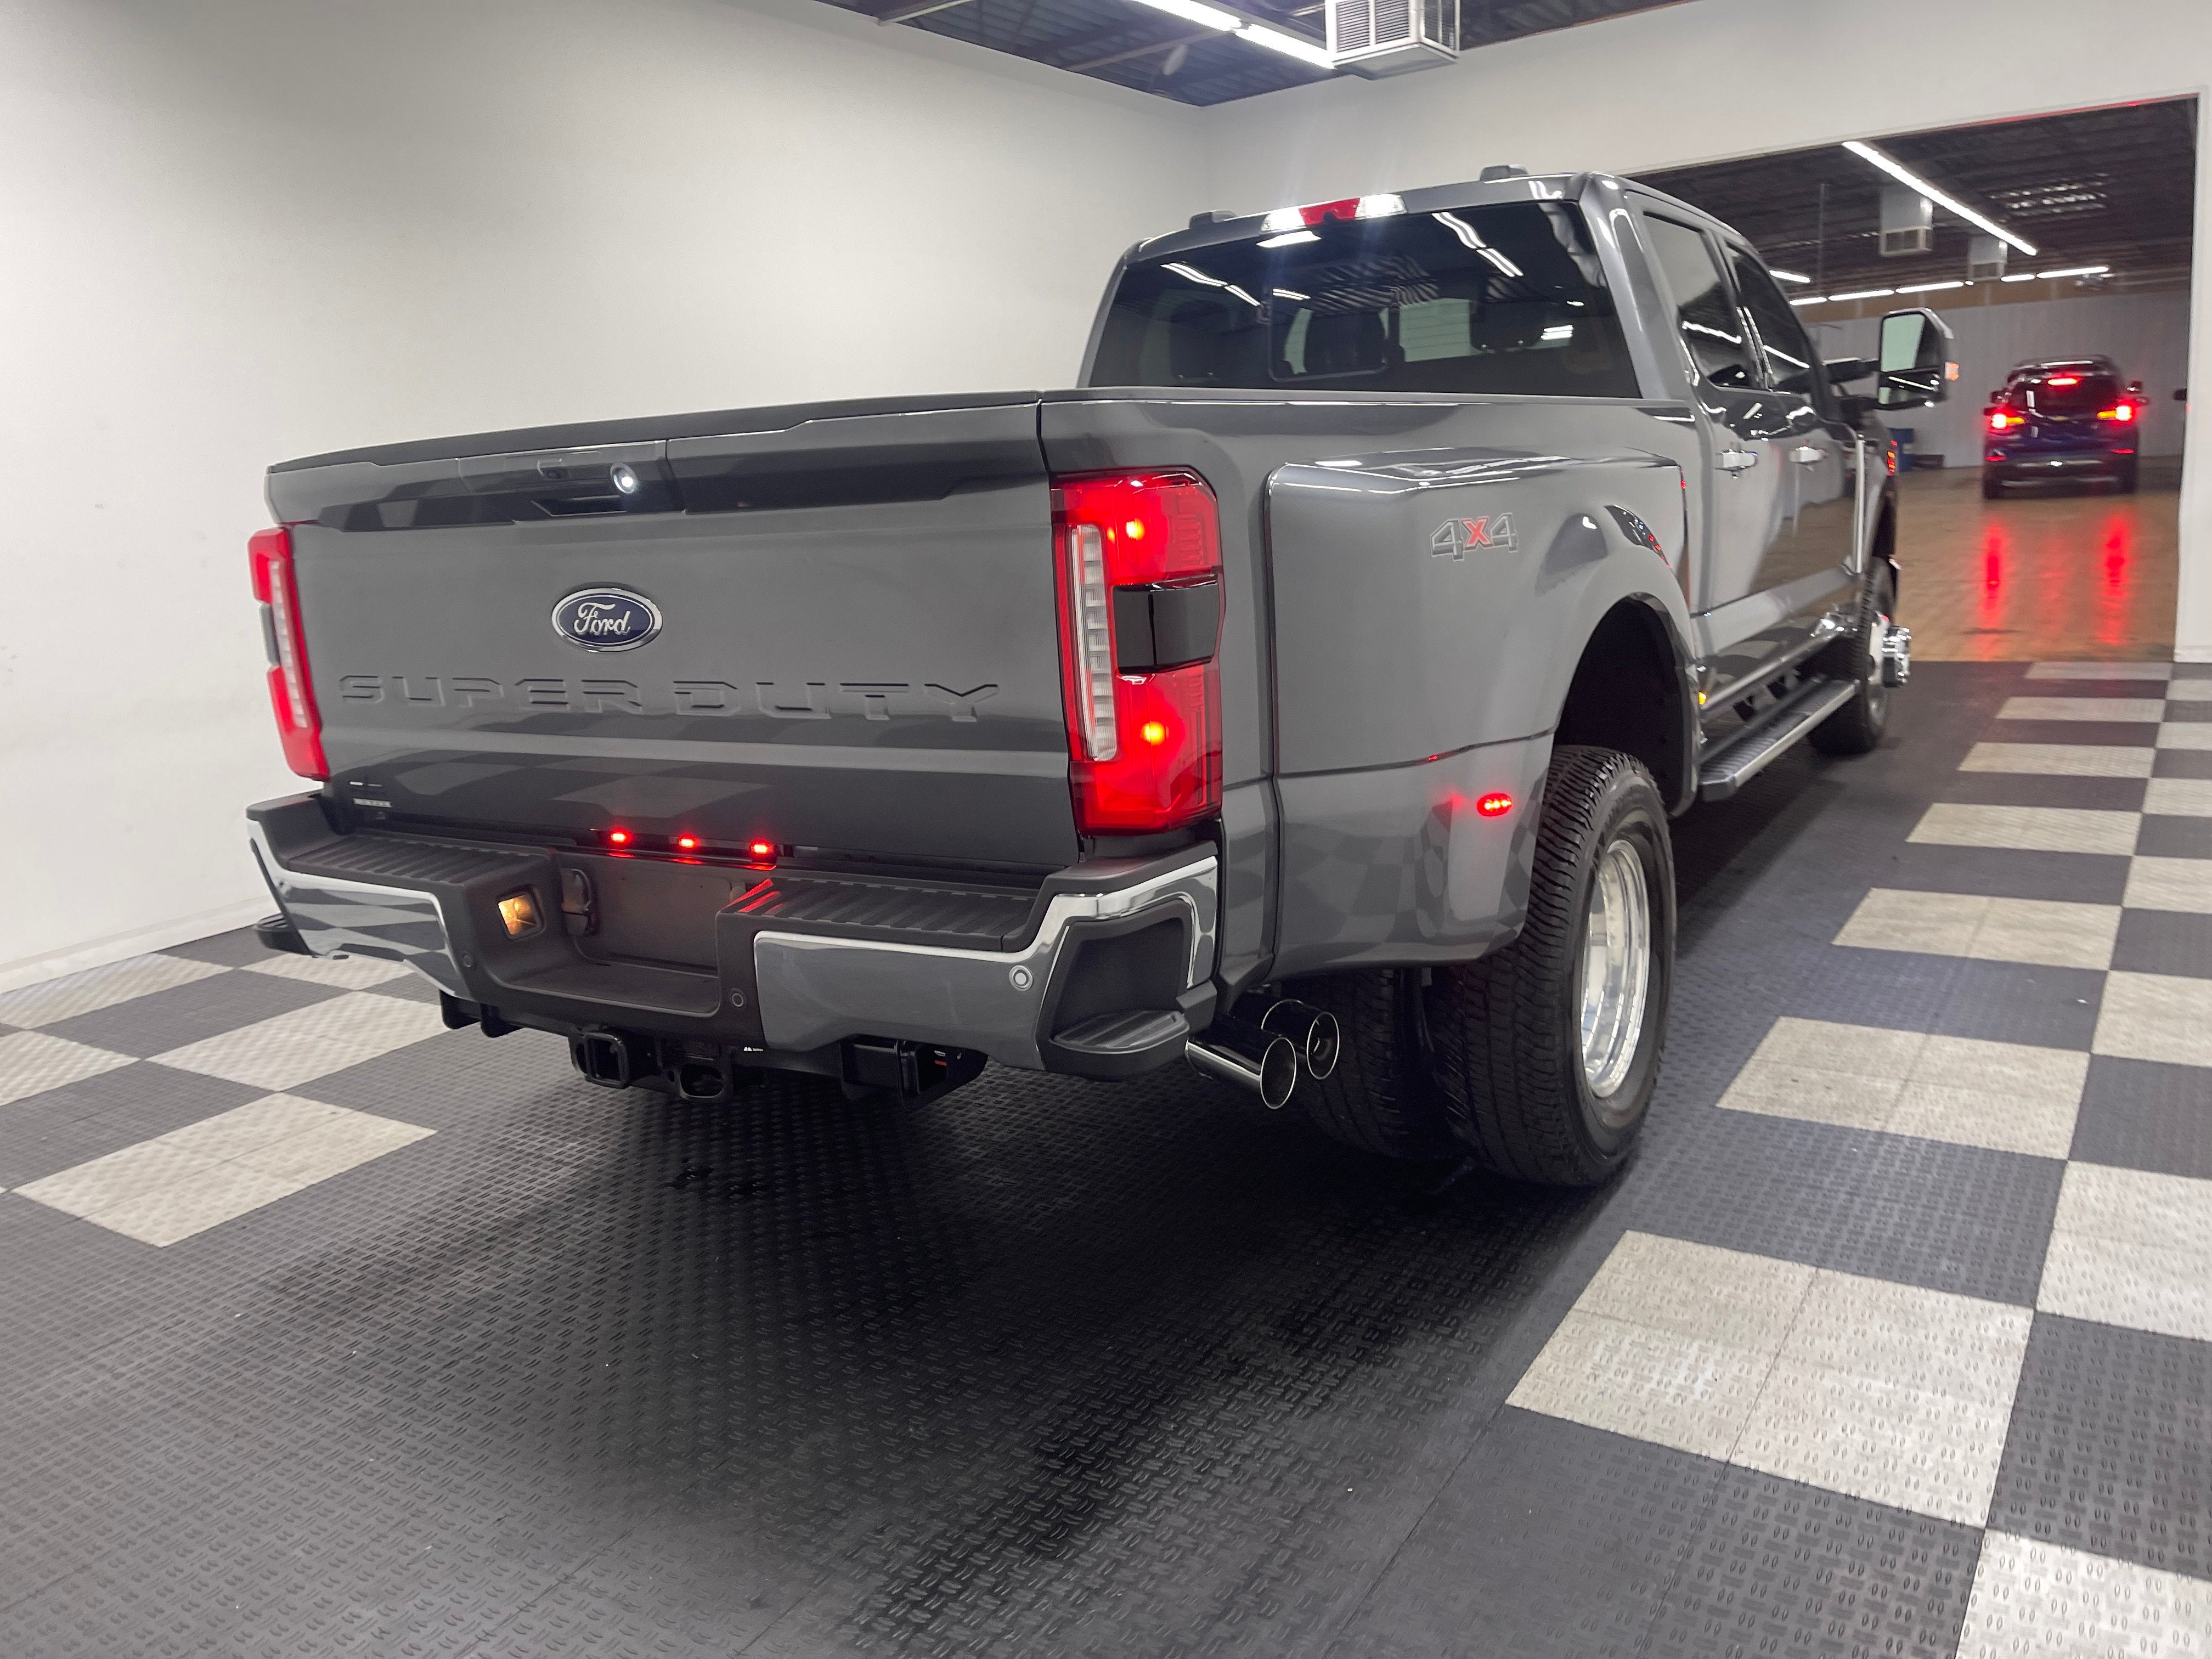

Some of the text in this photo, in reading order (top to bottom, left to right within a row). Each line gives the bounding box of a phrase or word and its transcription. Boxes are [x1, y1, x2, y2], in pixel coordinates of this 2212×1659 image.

[573, 601, 631, 636] Ford
[338, 675, 998, 723] SUPER DUTY
